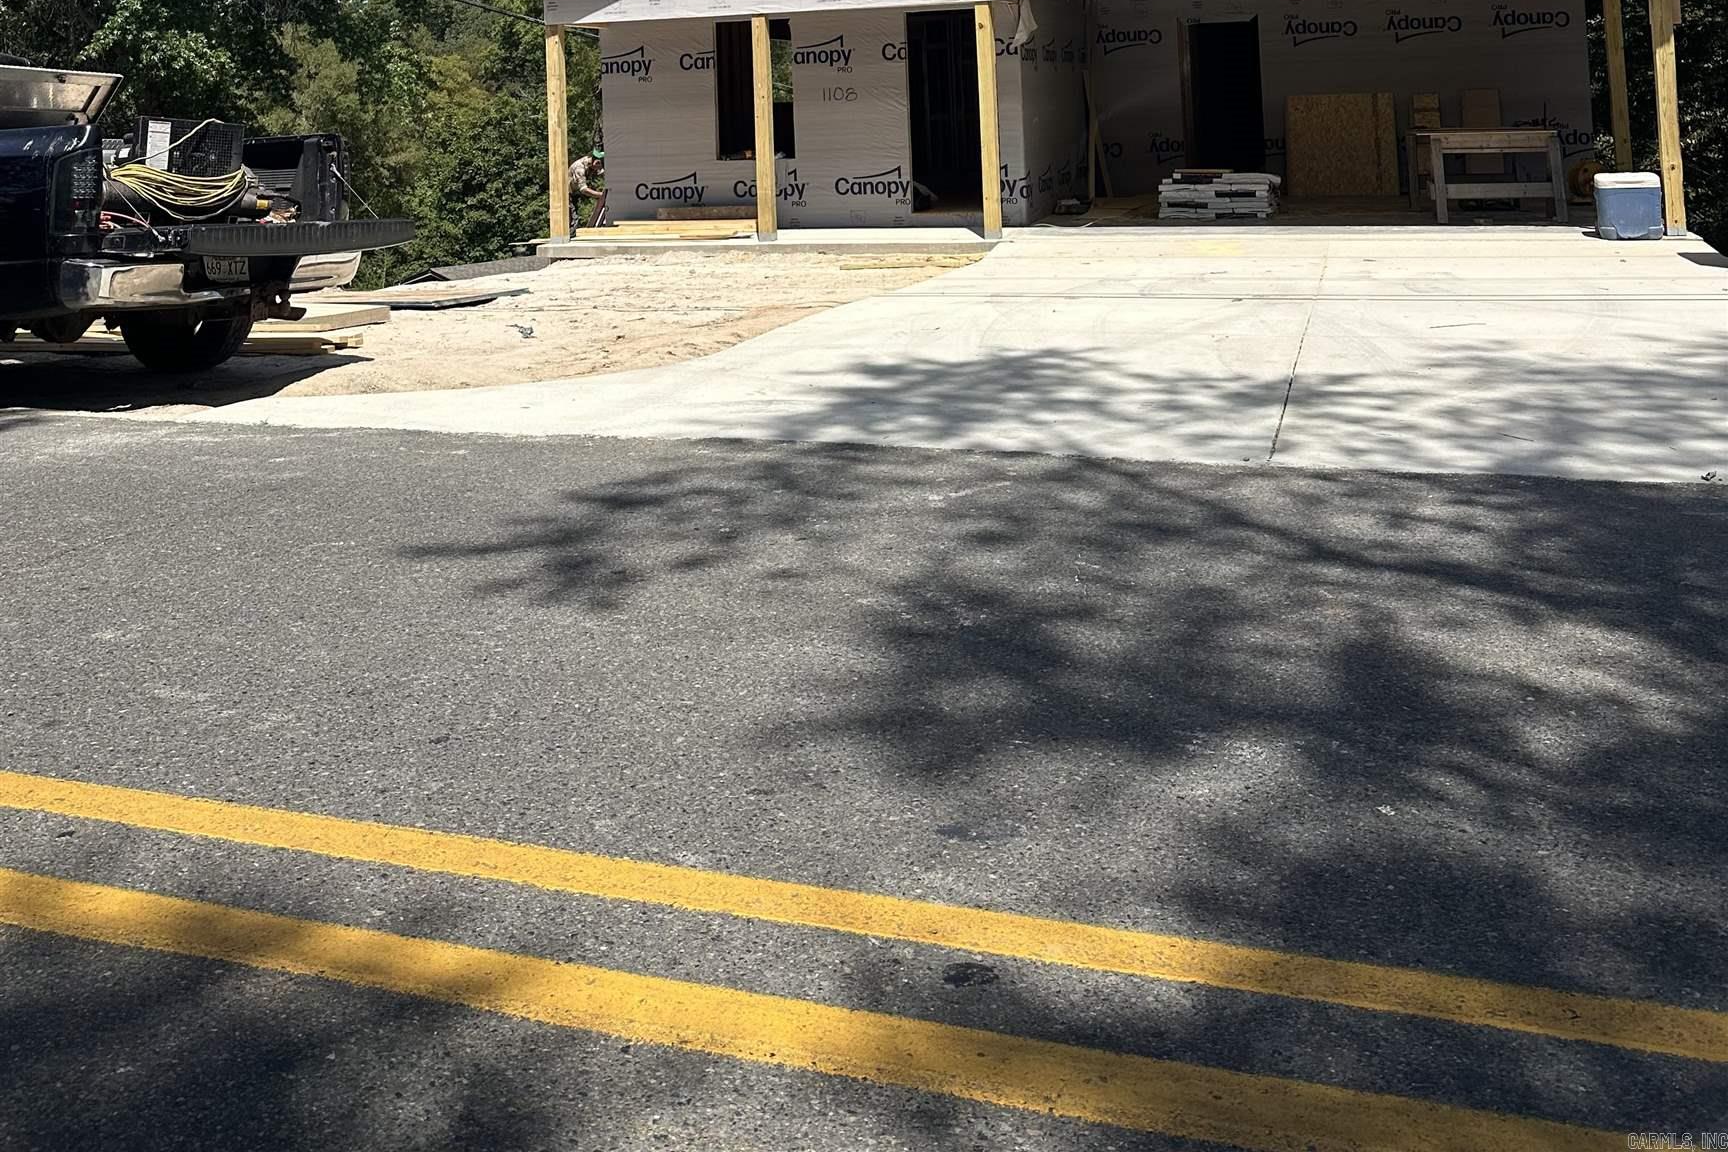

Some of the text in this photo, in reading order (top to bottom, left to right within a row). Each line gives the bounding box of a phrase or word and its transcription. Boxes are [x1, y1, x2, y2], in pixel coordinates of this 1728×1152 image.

[1387, 15, 1462, 32] Canopy
[1493, 10, 1570, 28] Canopy
[1285, 19, 1358, 36] Canopy
[1096, 29, 1162, 45] Canopy
[837, 66, 853, 74] PRO
[635, 183, 705, 203] Canopy
[835, 177, 910, 198] Canopy
[791, 200, 807, 208] PRO
[895, 198, 911, 206] PRO
[228, 260, 247, 275] XTZ
